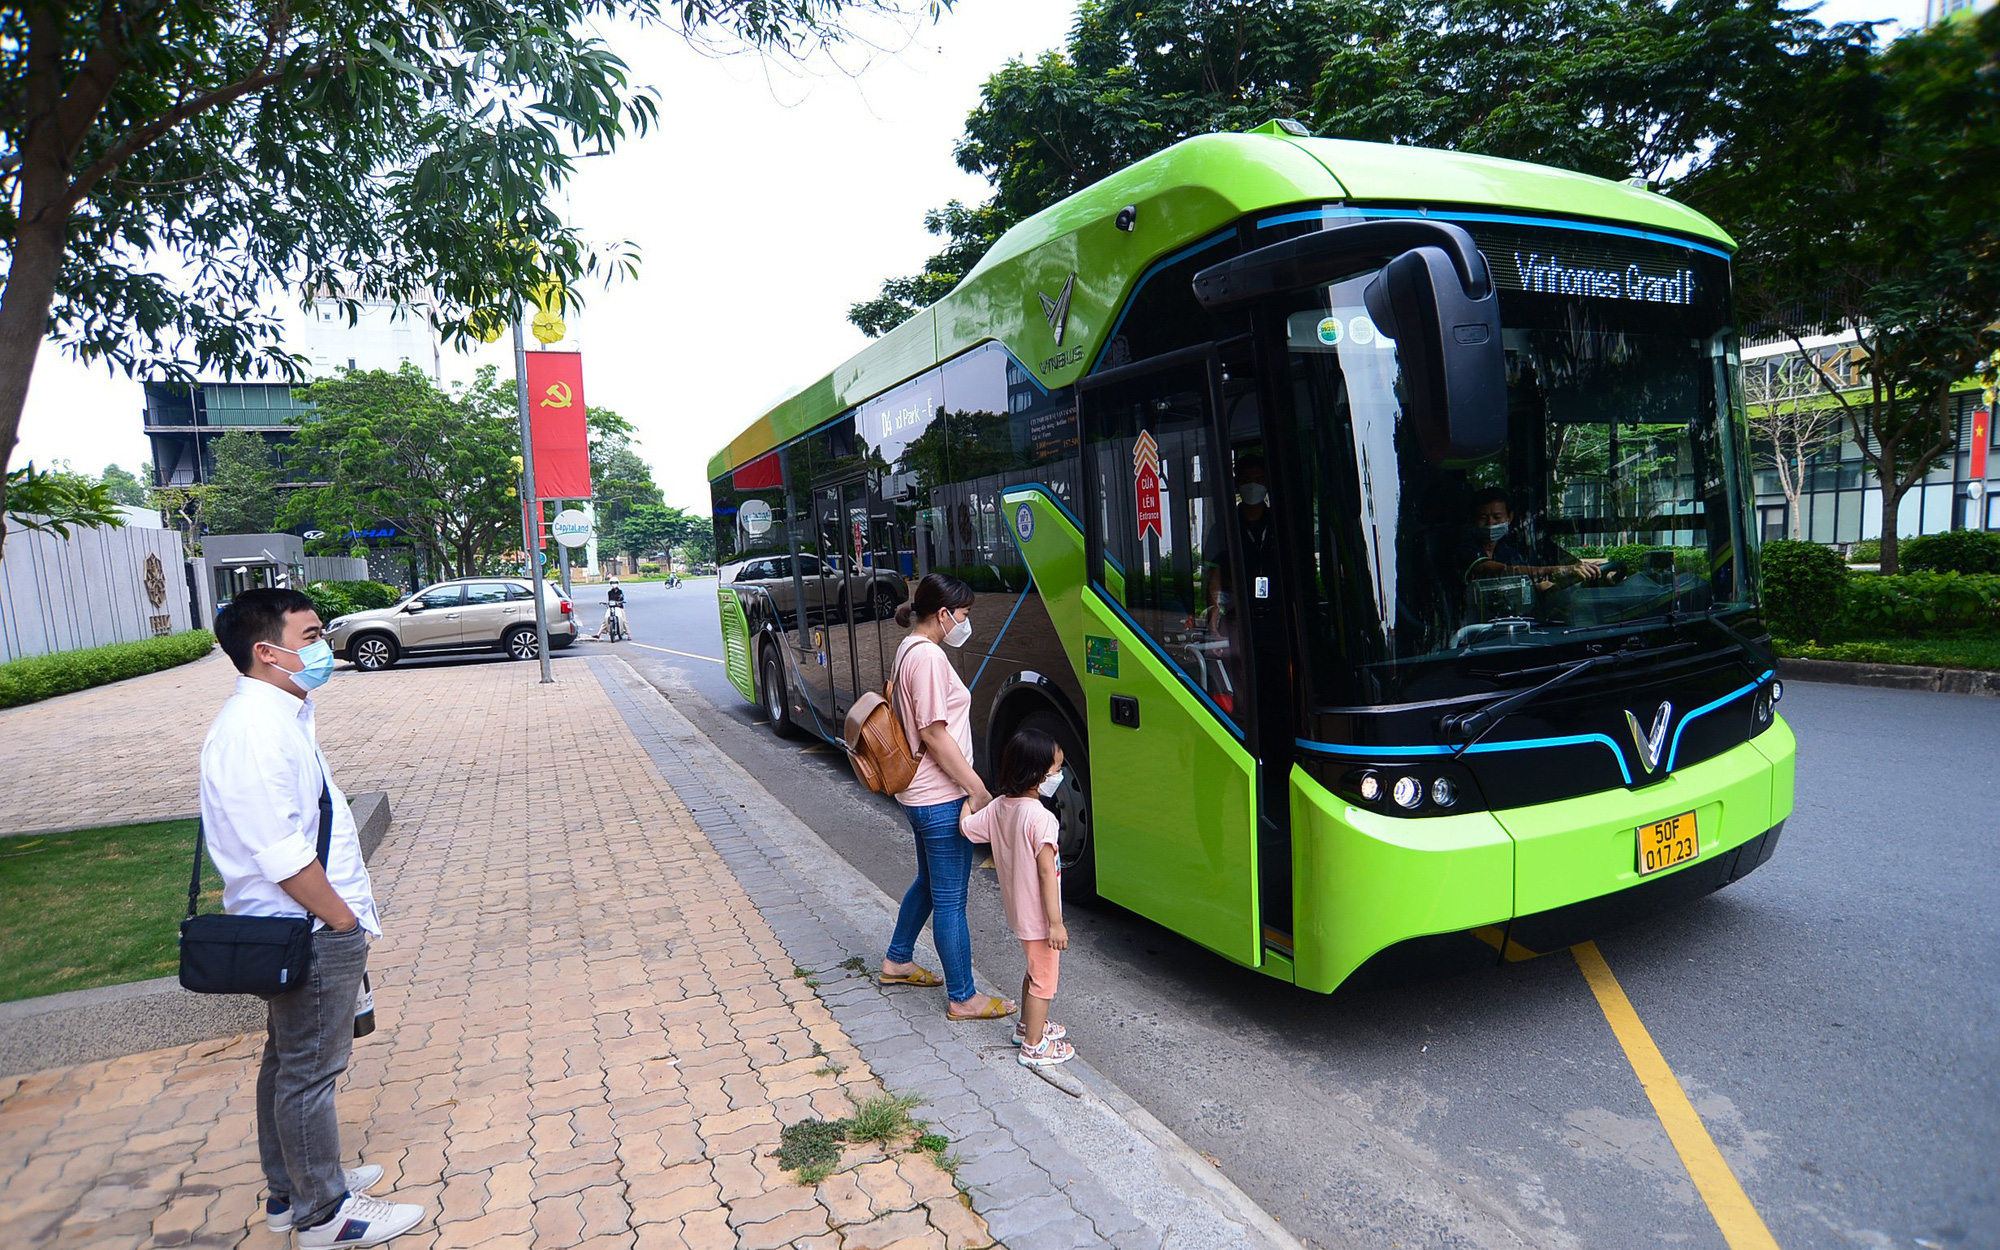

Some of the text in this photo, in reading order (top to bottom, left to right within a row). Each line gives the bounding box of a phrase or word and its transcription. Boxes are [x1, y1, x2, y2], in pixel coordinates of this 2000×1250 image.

[1514, 252, 1620, 299] Vinhomes
[1626, 263, 1682, 304] Grand
[1038, 344, 1083, 375] VINBUS
[1142, 494, 1155, 509] LÊN
[1139, 511, 1160, 521] Entrance
[1655, 818, 1680, 844] 50F
[1646, 837, 1692, 870] 017.23
